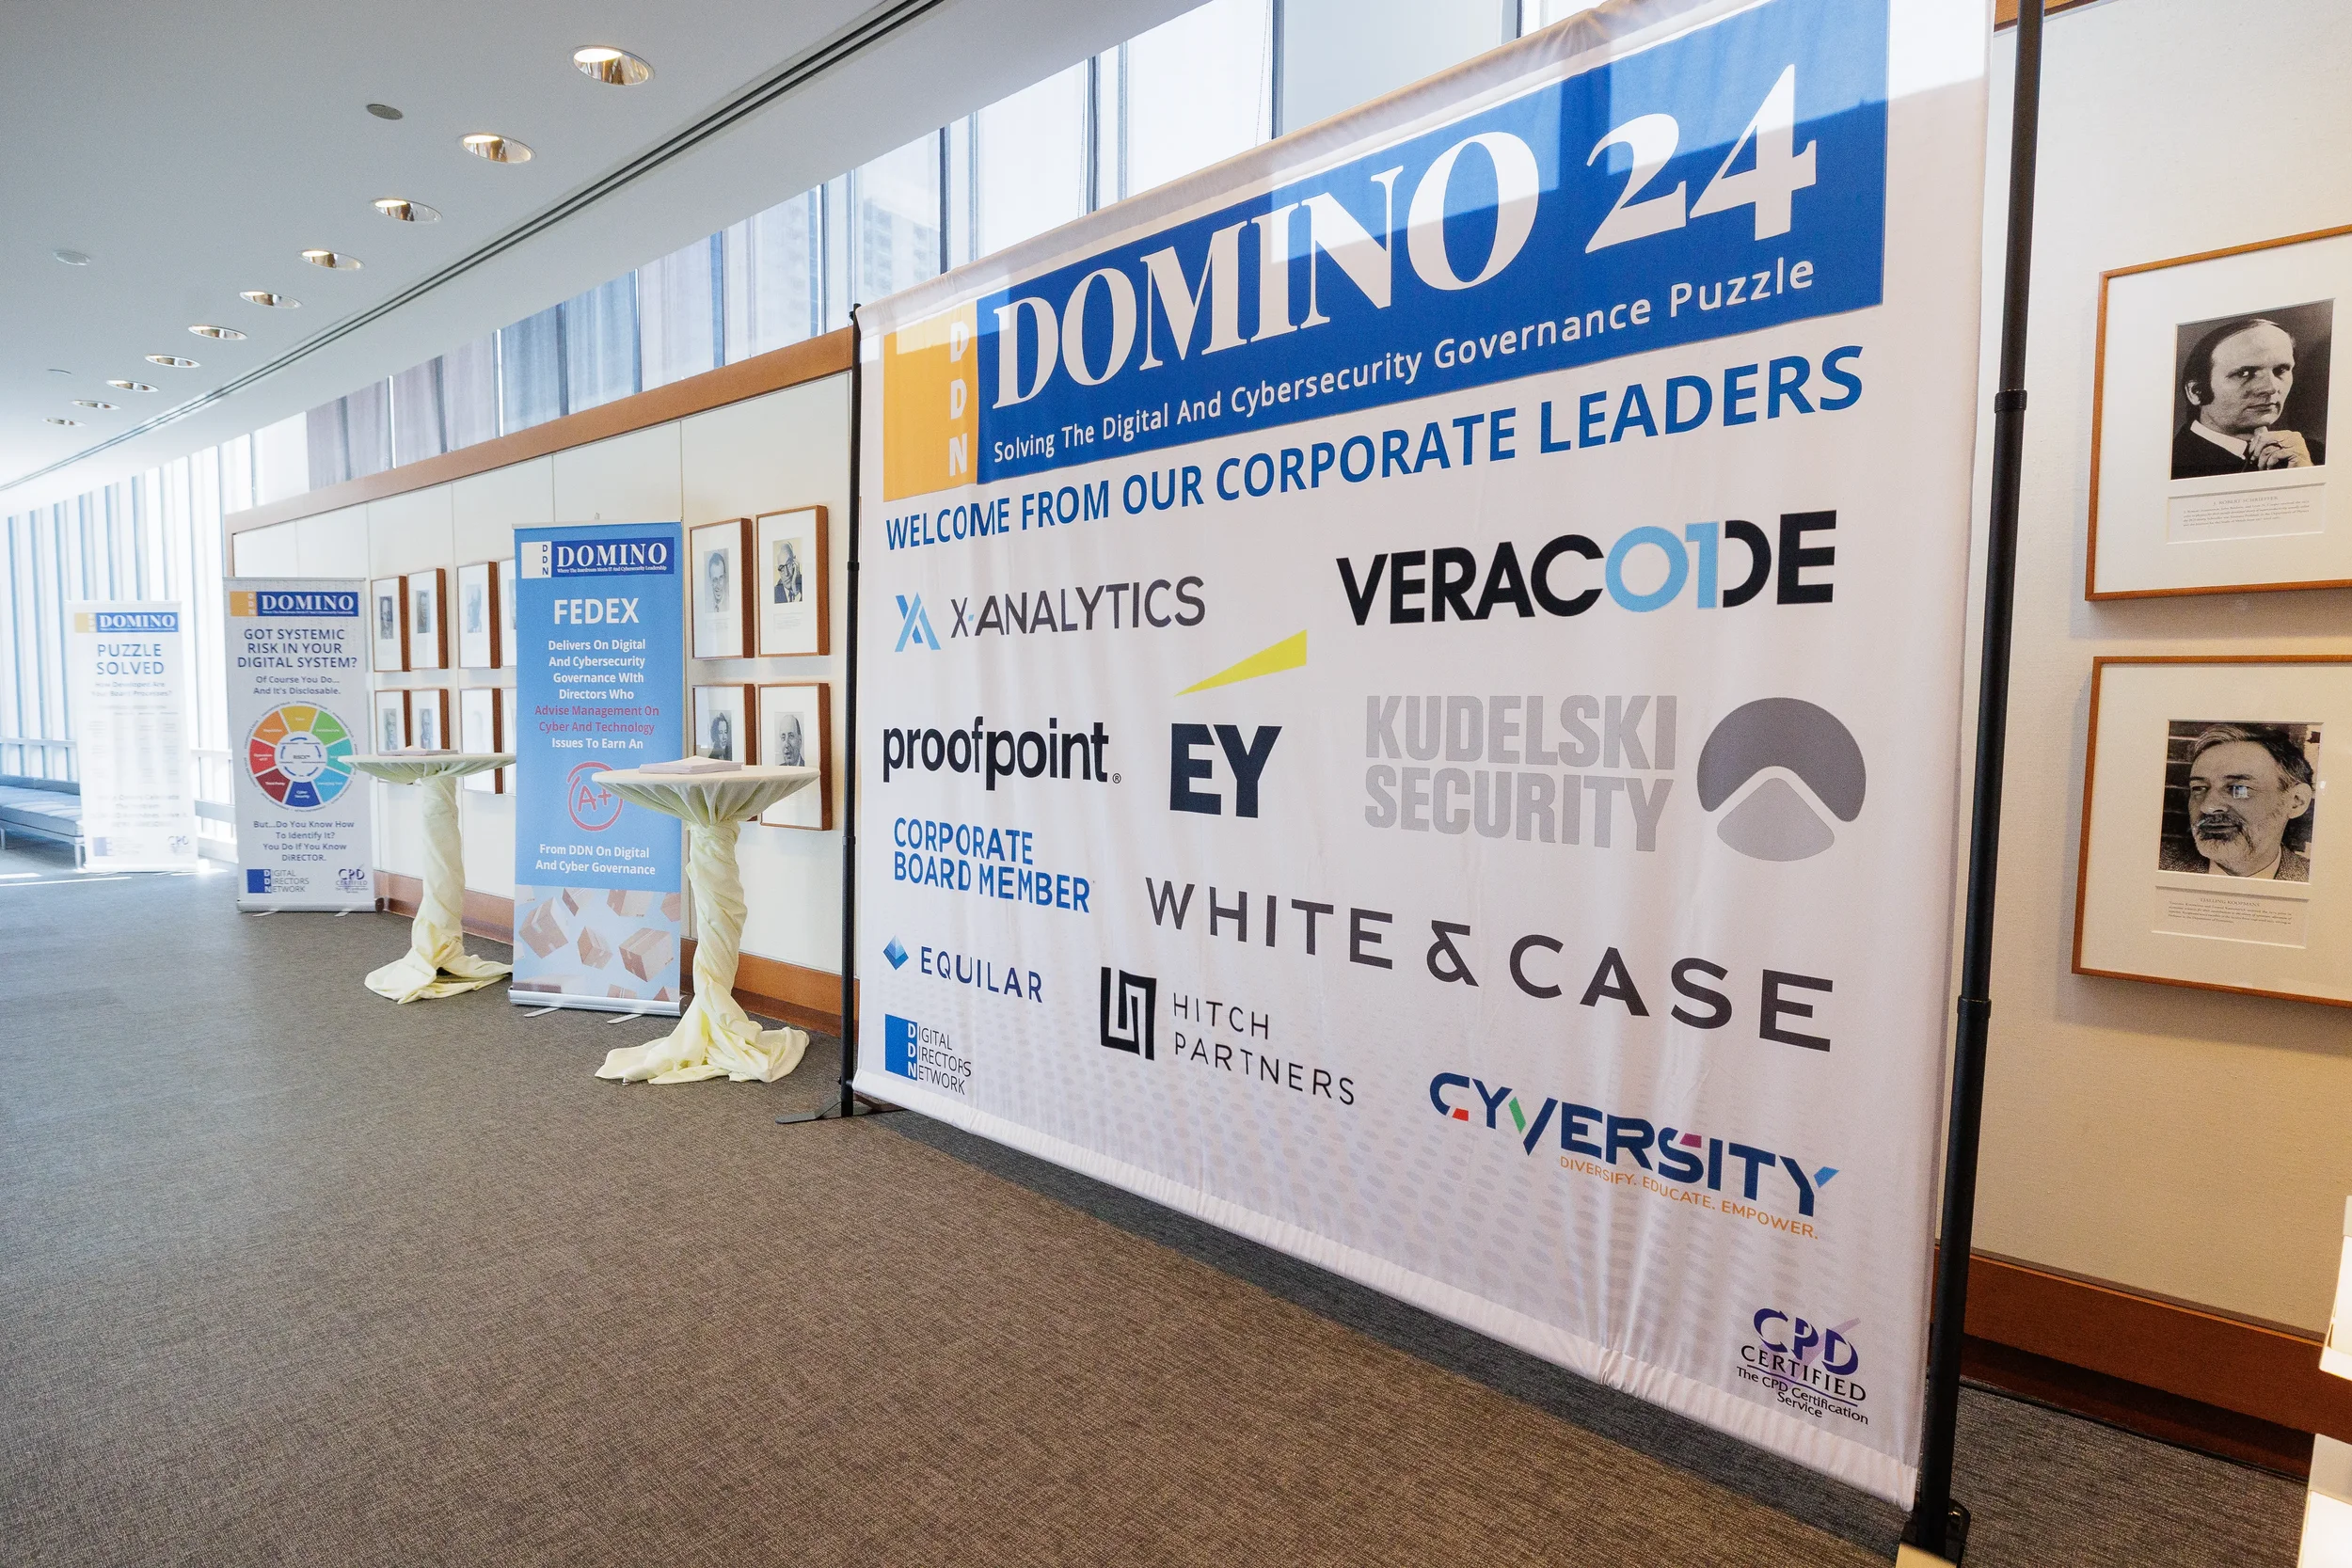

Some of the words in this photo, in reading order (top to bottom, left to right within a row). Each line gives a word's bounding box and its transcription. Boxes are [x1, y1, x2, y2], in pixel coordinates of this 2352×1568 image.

[993, 131, 1539, 408] DOMINO
[1585, 64, 1817, 253] 24
[994, 434, 1055, 463] Solving
[1061, 423, 1094, 449] The
[1104, 403, 1168, 442] Digital
[1177, 390, 1221, 425] And
[1231, 352, 1422, 418] Cybersecurity
[1435, 297, 1650, 369] Governance
[1671, 257, 1814, 318] Puzzle
[886, 497, 1009, 550] WELCOME
[1022, 480, 1109, 531] FROM
[1122, 466, 1204, 515] OUR
[1216, 406, 1516, 500] CORPORATE
[1540, 345, 1864, 453] LEADERS
[557, 542, 667, 567] DOMINO
[262, 595, 354, 610] DOMINO
[554, 598, 639, 624] FEDEX
[99, 614, 175, 627] DOMINO
[245, 628, 273, 640] GOT
[278, 628, 345, 640] SYSTEMIC
[548, 640, 591, 650] Delivers
[594, 640, 609, 650] On
[612, 639, 645, 652] Digital
[97, 643, 162, 657] PUZZLE
[247, 643, 278, 654] RISK
[283, 643, 298, 654] IN
[302, 643, 342, 654] YOUR
[97, 661, 165, 675] SOLVED
[238, 657, 294, 668] DIGITAL
[297, 657, 358, 668] SYSTEM?
[548, 657, 570, 667] And
[572, 657, 645, 669] Cybersecurity
[269, 675, 299, 684] Course
[302, 675, 318, 684] You
[553, 673, 616, 683] Governance
[289, 687, 341, 695] Disclosable.
[559, 689, 607, 699] Directors
[610, 689, 635, 699] Who
[534, 705, 569, 715] Advise
[572, 706, 642, 718] Management
[644, 706, 660, 716] On
[539, 721, 569, 734] Cyber
[571, 721, 593, 732] And
[596, 722, 655, 736] Technology
[1365, 694, 1677, 770] KUDELSKI
[552, 737, 583, 748] Issues
[585, 737, 599, 749] To
[601, 738, 626, 749] Earn
[628, 738, 644, 749] An
[1169, 722, 1282, 818] EY
[578, 784, 612, 812] A+
[1364, 765, 1674, 852] SECURITY
[289, 832, 322, 840] Identify
[894, 817, 1033, 865] CORPORATE
[539, 844, 566, 854] From
[569, 846, 594, 856] DDN
[596, 846, 612, 857] On
[614, 847, 650, 860] Digital
[339, 868, 365, 879] CPD
[535, 860, 557, 870] And
[559, 861, 589, 873] Cyber
[592, 863, 656, 875] Governance
[895, 851, 972, 891] BOARD
[979, 863, 1089, 913] MEMBER
[921, 946, 1042, 1003] EQUILAR
[1145, 877, 1393, 970] WHITE
[1426, 919, 1480, 987] &
[1509, 934, 1834, 1053] CASE
[1173, 992, 1268, 1039] HITCH
[1175, 1032, 1355, 1105] PARTNERS
[1429, 1072, 1840, 1217] CYVERSITY
[1559, 1155, 1637, 1187] DIVERSIFY.
[1643, 1175, 1715, 1211] EDUCATE.
[1721, 1199, 1819, 1240] EMPOWER.
[1754, 1308, 1859, 1375] CPD
[1740, 1345, 1867, 1402] CERTIFIED
[1737, 1367, 1758, 1382] The
[1762, 1376, 1788, 1392] CPD
[1791, 1386, 1868, 1425] Certification
[1777, 1391, 1822, 1418] Service
